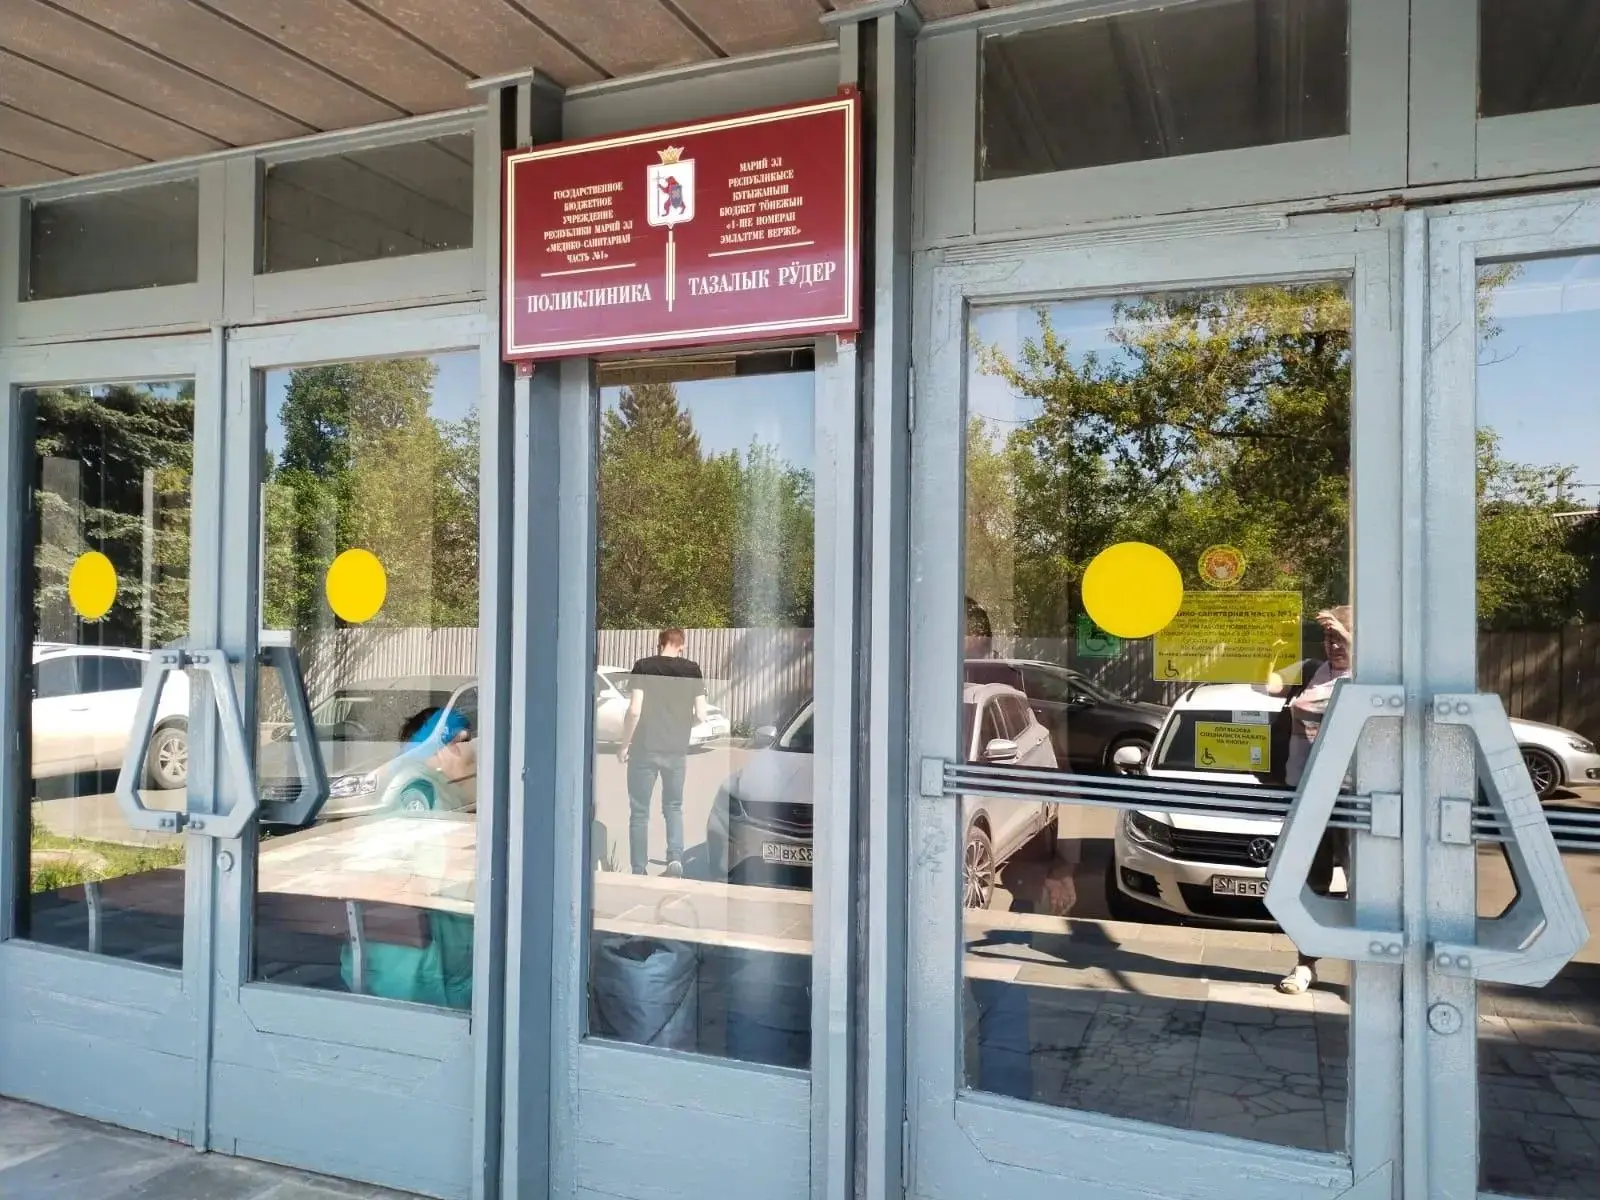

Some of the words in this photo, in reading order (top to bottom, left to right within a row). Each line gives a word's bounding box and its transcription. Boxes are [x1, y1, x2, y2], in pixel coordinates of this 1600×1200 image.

[739, 157, 768, 173] МАРИЙ
[770, 156, 782, 168] ЭЛ
[728, 169, 794, 188] РЕСПУБЛИКЫСЕ
[553, 182, 624, 200] ГОСУДАРСТВЕННОЕ
[564, 197, 613, 212] БЮДЖЕТНОЕ
[719, 203, 757, 217] БЮДЖЕТ
[562, 209, 614, 225] УЧРЕЖДЕНИЕ
[756, 211, 796, 226] НОМЕРАН
[543, 226, 592, 241] РЕСПУБЛИКИ
[594, 220, 621, 234] МАРИЙ
[622, 220, 633, 231] ЭЛ
[567, 252, 590, 263] ЧАСТЬ
[688, 269, 770, 296] ТАЗАЛЫК
[527, 282, 652, 313] ПОЛИКЛИНИКА
